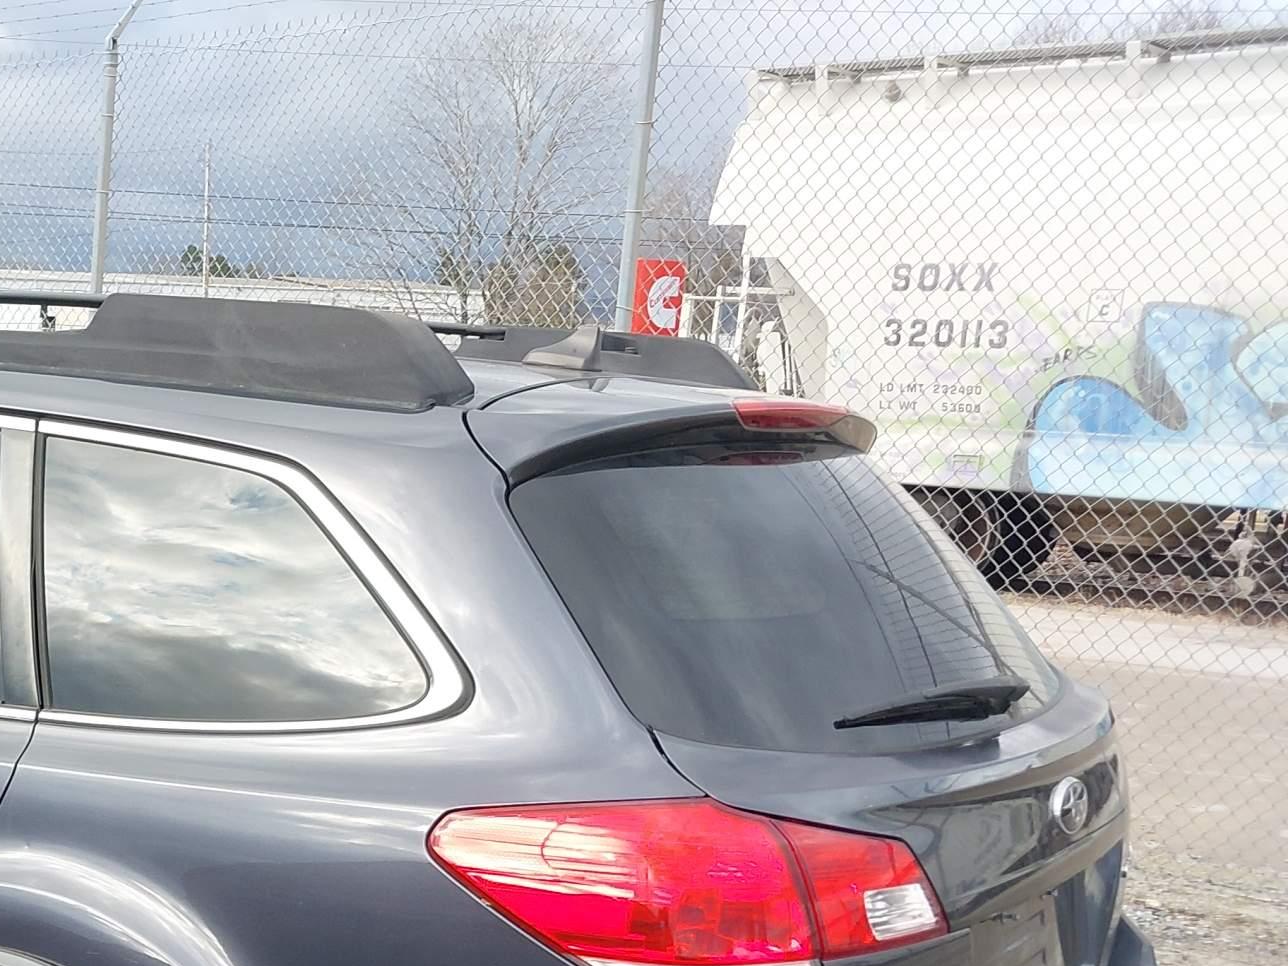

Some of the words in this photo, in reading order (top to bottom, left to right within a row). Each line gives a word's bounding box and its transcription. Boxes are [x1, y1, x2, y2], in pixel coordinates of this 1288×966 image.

[891, 262, 999, 292] SOXX
[883, 318, 1009, 349] 320113
[900, 383, 924, 393] LMT
